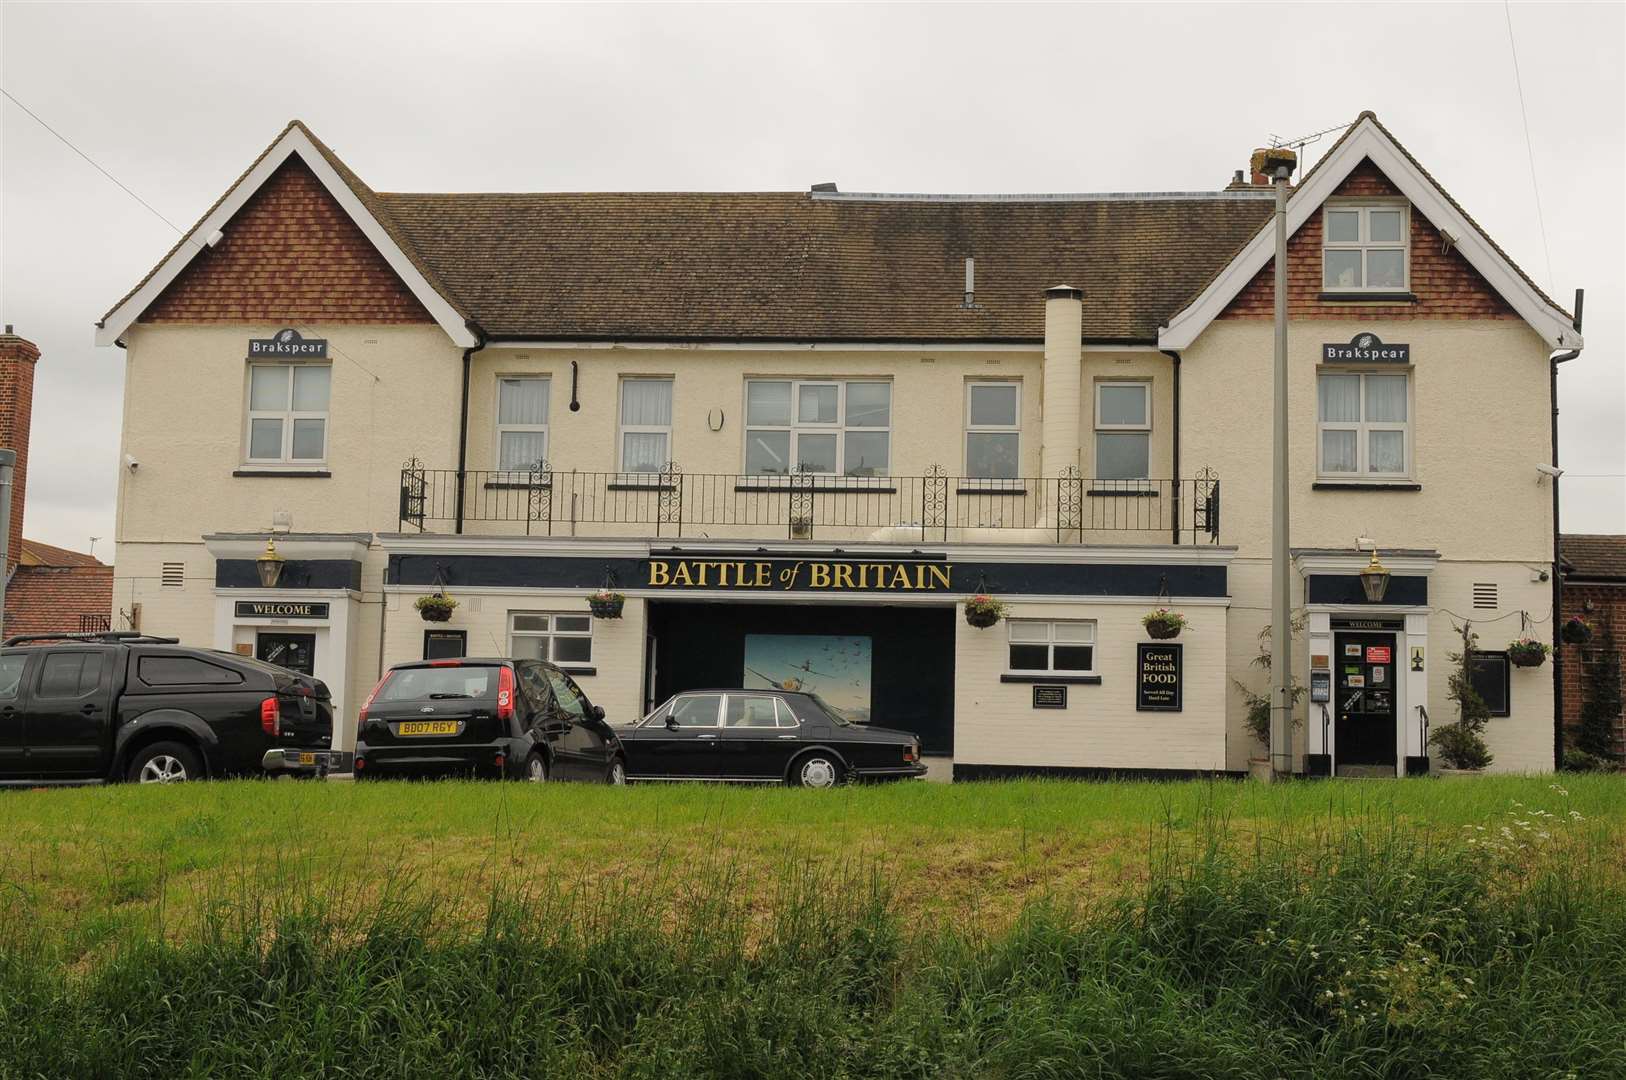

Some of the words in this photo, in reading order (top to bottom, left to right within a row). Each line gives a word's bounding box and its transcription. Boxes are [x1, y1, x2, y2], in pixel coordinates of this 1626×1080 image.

[253, 342, 323, 354] Brakspear
[1328, 347, 1405, 360] Brakspear
[648, 561, 772, 587] BATTLE
[780, 562, 804, 590] of
[809, 563, 953, 589] BRITAIN
[254, 604, 312, 615] WELCOME
[1349, 620, 1383, 629] WELCOME
[1146, 652, 1173, 661] Great
[1143, 662, 1176, 671] British
[1143, 673, 1177, 684] FOOD
